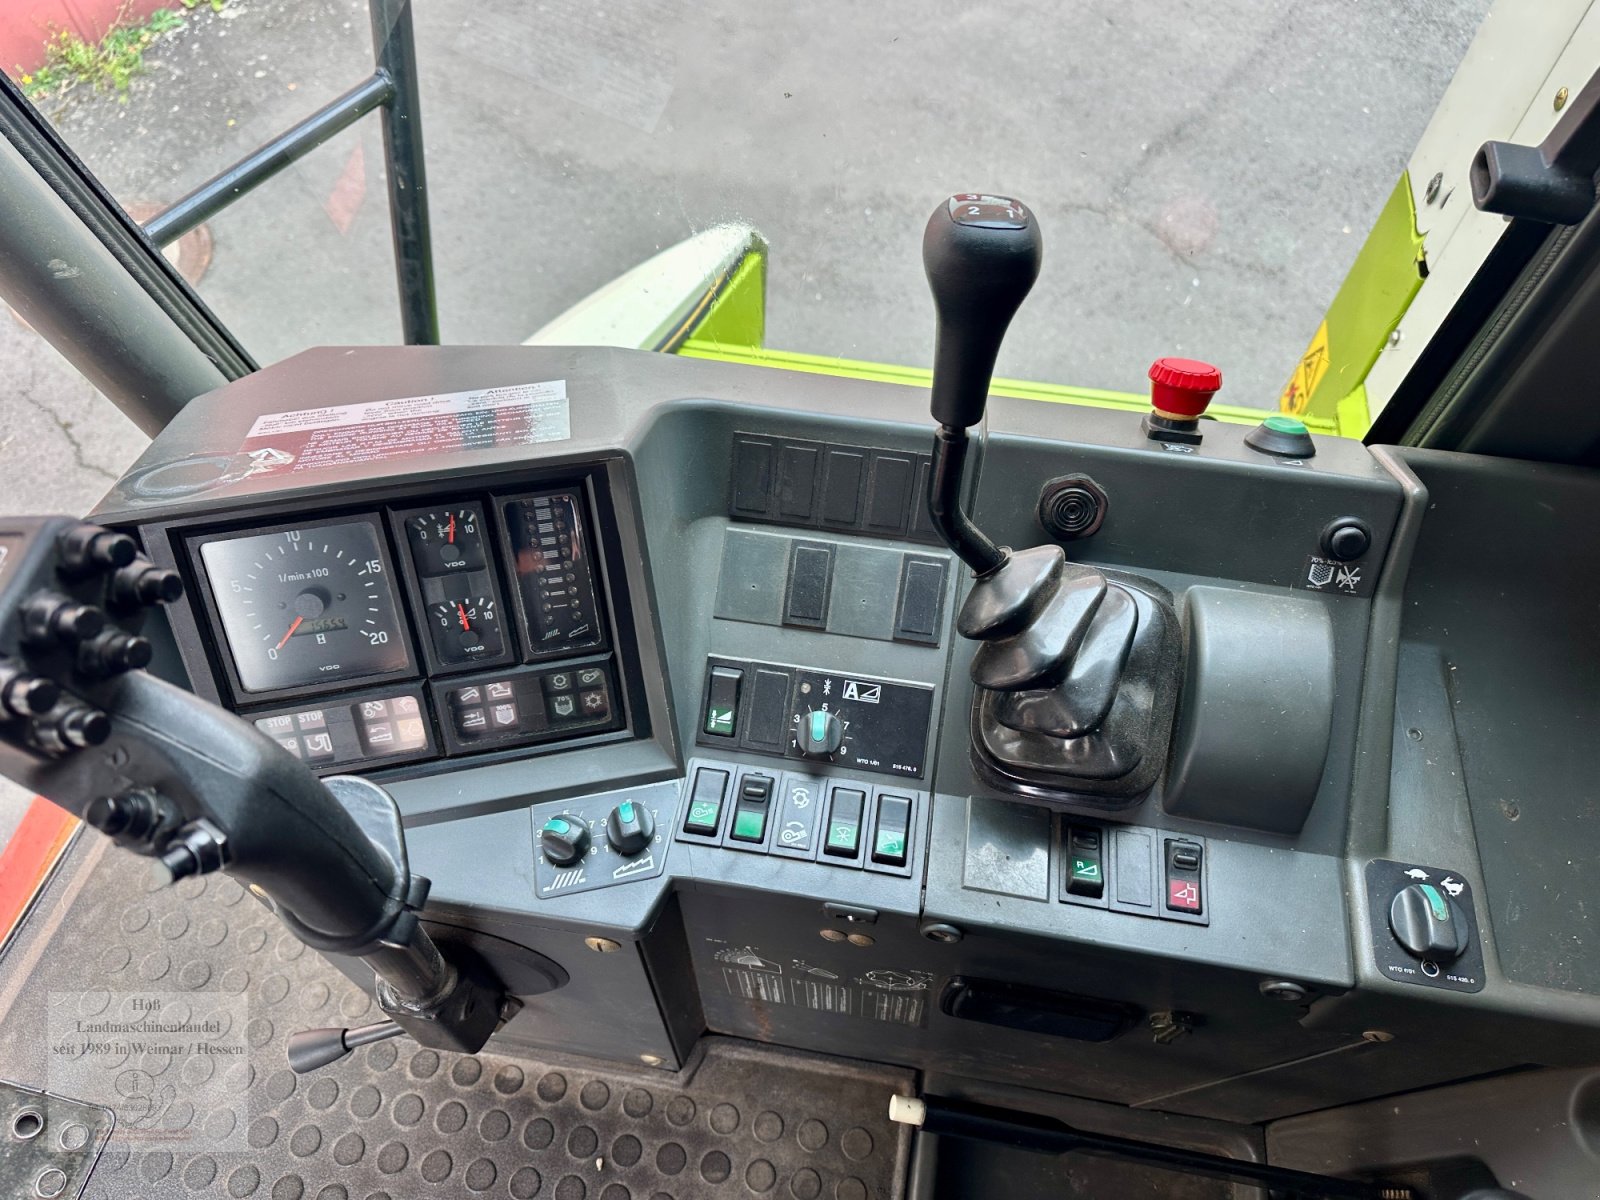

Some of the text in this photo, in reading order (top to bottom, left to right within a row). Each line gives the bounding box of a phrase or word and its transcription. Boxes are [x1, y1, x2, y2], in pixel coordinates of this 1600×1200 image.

[968, 206, 980, 215] 2
[1006, 209, 1014, 218] 1
[464, 524, 474, 534] 10
[285, 530, 301, 542] 10
[420, 530, 427, 539] 0
[365, 559, 382, 574] 15
[444, 560, 466, 568] VDO
[231, 580, 241, 593] 5
[483, 610, 493, 620] 10
[441, 618, 448, 627] 0
[368, 630, 388, 645] 20
[464, 645, 485, 653] VDO
[268, 648, 278, 660] 0
[319, 664, 340, 672] VDO
[844, 682, 859, 700] A
[821, 703, 829, 712] 5
[298, 711, 323, 723] STOP
[793, 714, 801, 723] 3
[267, 716, 291, 728] STOP
[843, 721, 850, 730] 7
[791, 739, 797, 748] 1
[840, 746, 847, 755] 9
[652, 809, 658, 818] 7
[588, 820, 595, 828] 7
[600, 818, 607, 827] 3
[536, 829, 543, 838] 3
[655, 835, 662, 843] 9
[591, 847, 598, 855] 9
[603, 844, 609, 853] 1
[538, 856, 544, 865] 1
[1388, 965, 1402, 973] WTO
